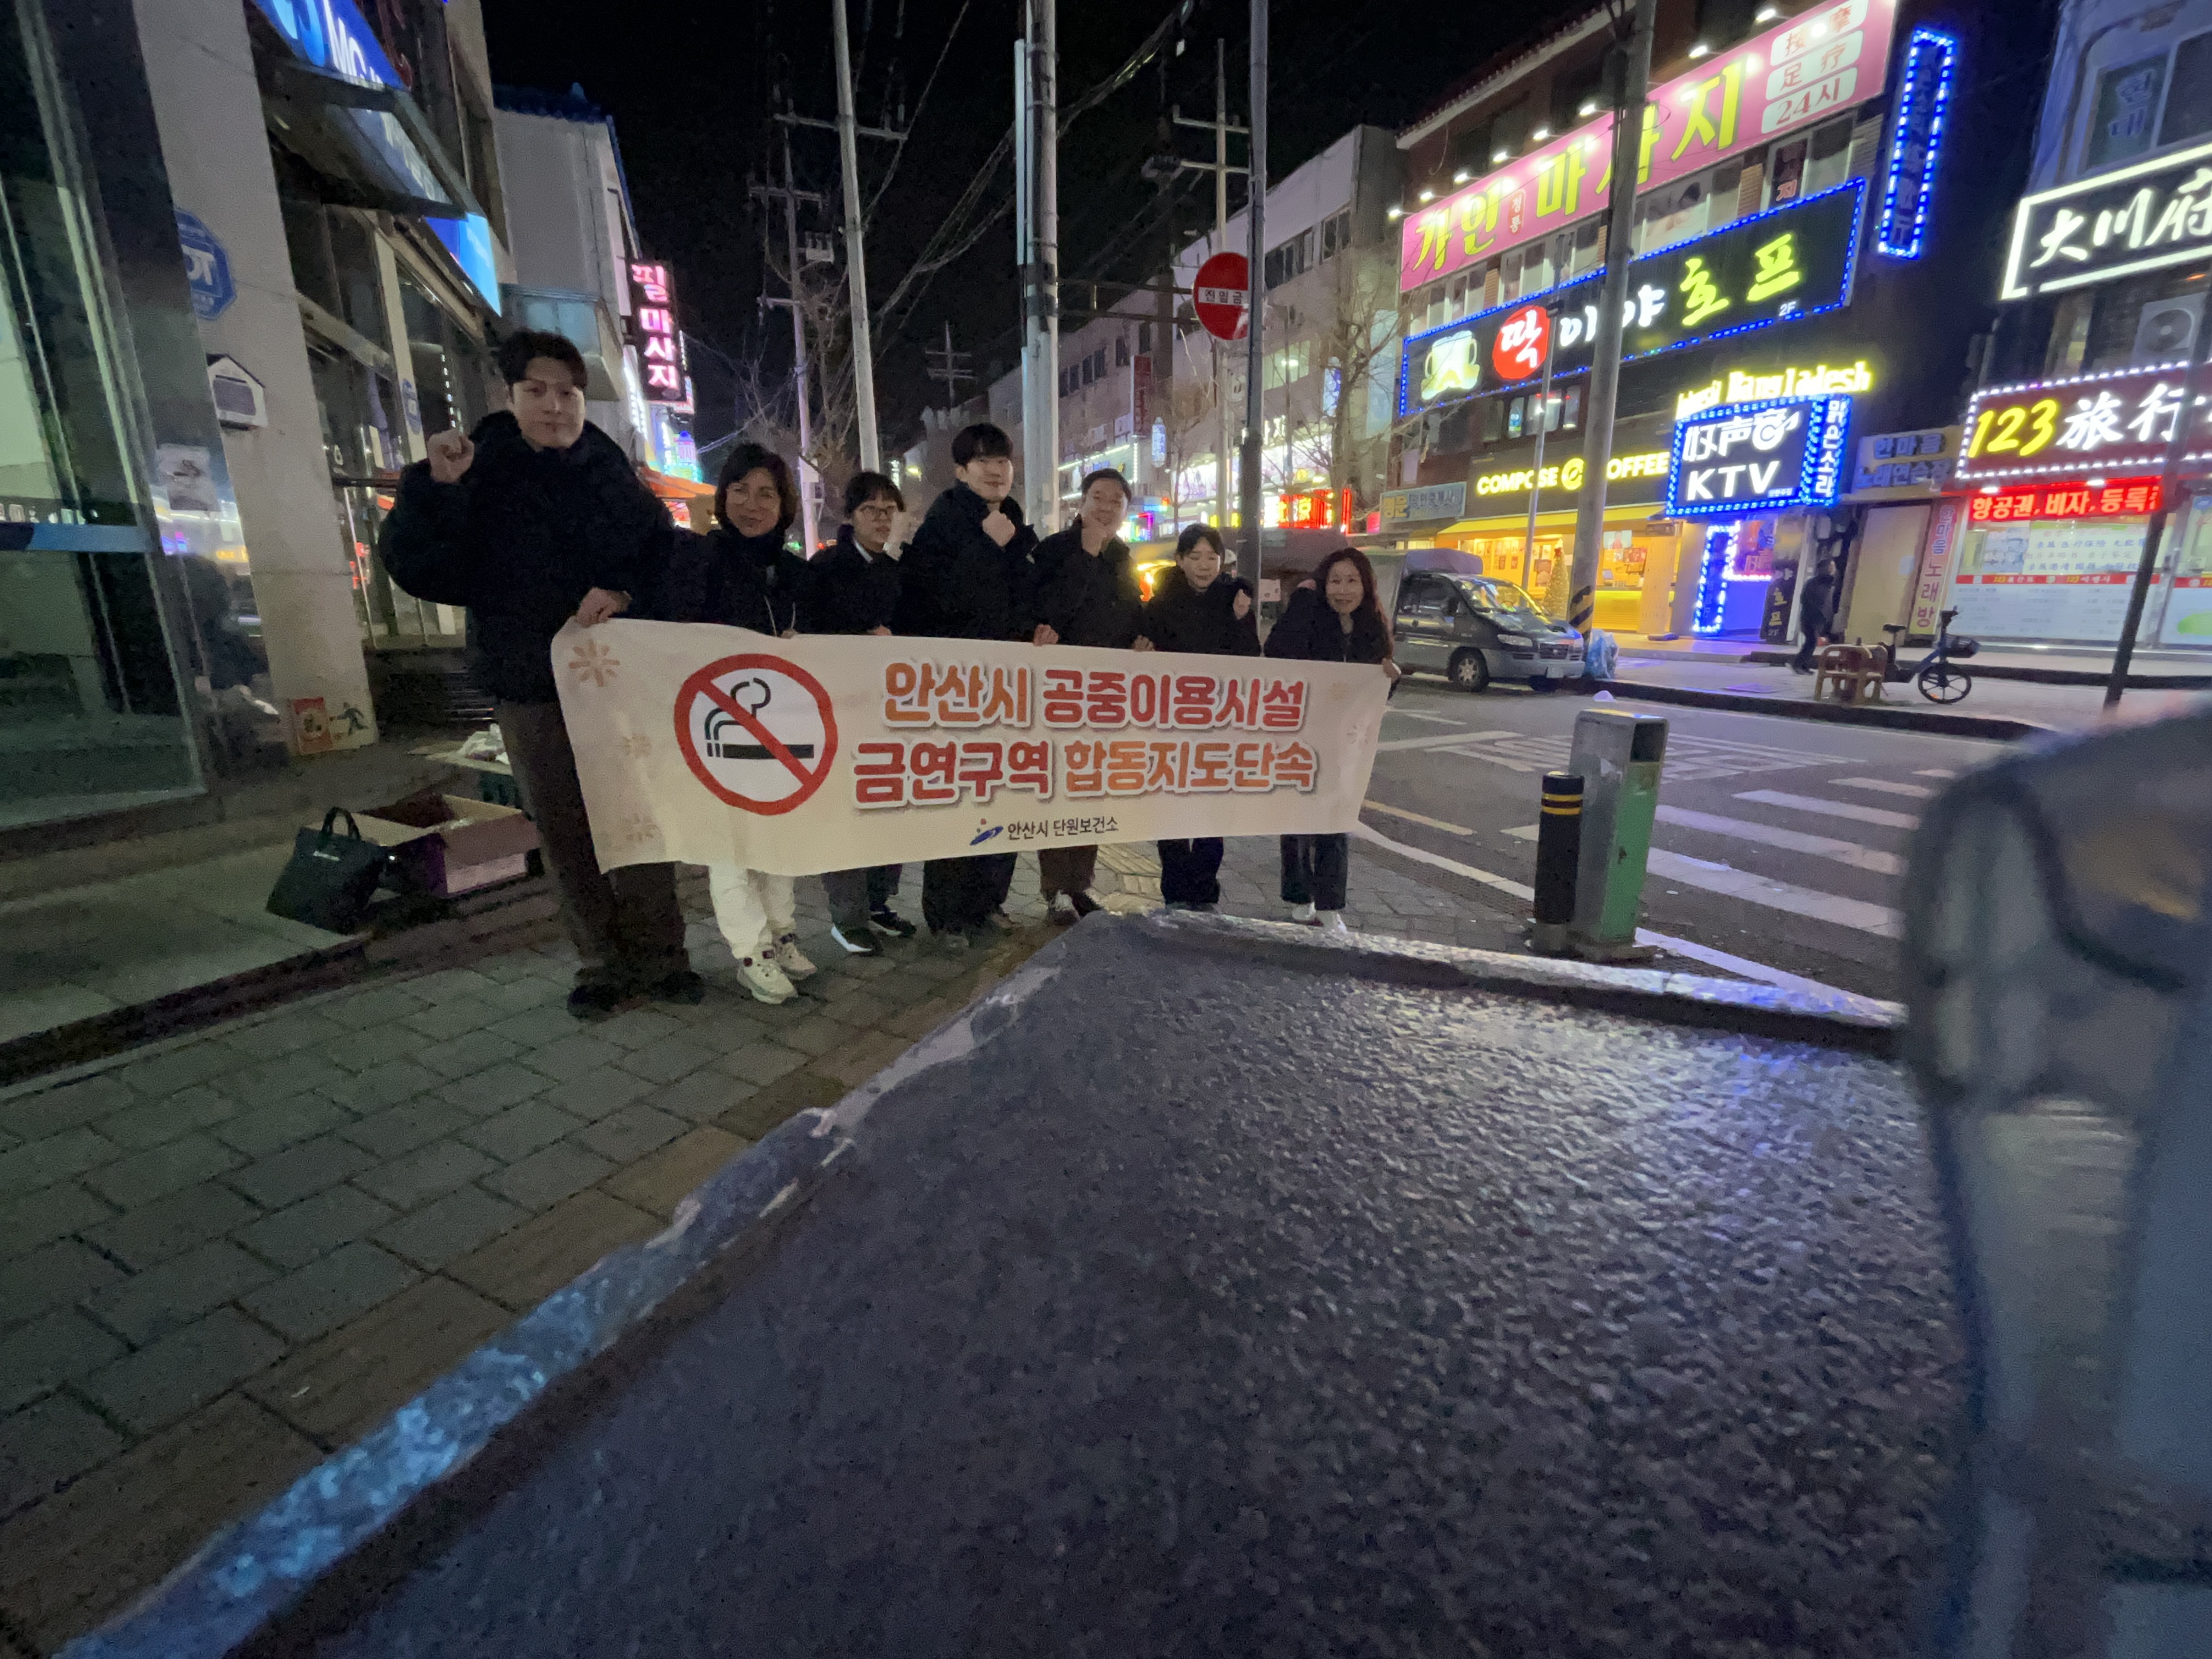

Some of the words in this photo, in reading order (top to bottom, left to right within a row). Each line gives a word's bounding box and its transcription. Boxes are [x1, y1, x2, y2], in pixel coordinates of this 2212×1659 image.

[1780, 42, 1848, 91] 足疗
[1776, 78, 1840, 126] 24시
[1413, 177, 1505, 272] 가인
[1510, 194, 1523, 234] 정통
[1204, 289, 1242, 304] 진입금
[1779, 301, 1798, 317] 2F
[1874, 433, 1943, 460] 한마음
[1477, 466, 1559, 495] COMPOSE
[1606, 452, 1670, 480] OFFEE
[1686, 460, 1781, 501] KTV
[1972, 494, 2040, 521] 항공권,
[2045, 492, 2095, 515] 비자,
[1917, 563, 1943, 628] 노래방
[884, 662, 1028, 724] 안산시
[1043, 669, 1305, 728] 공중이용시설
[854, 740, 1049, 804] 금연구역
[1063, 740, 1314, 791] 합동지도단속
[1007, 821, 1048, 841] 안산시
[1052, 816, 1119, 837] 단원보건소
